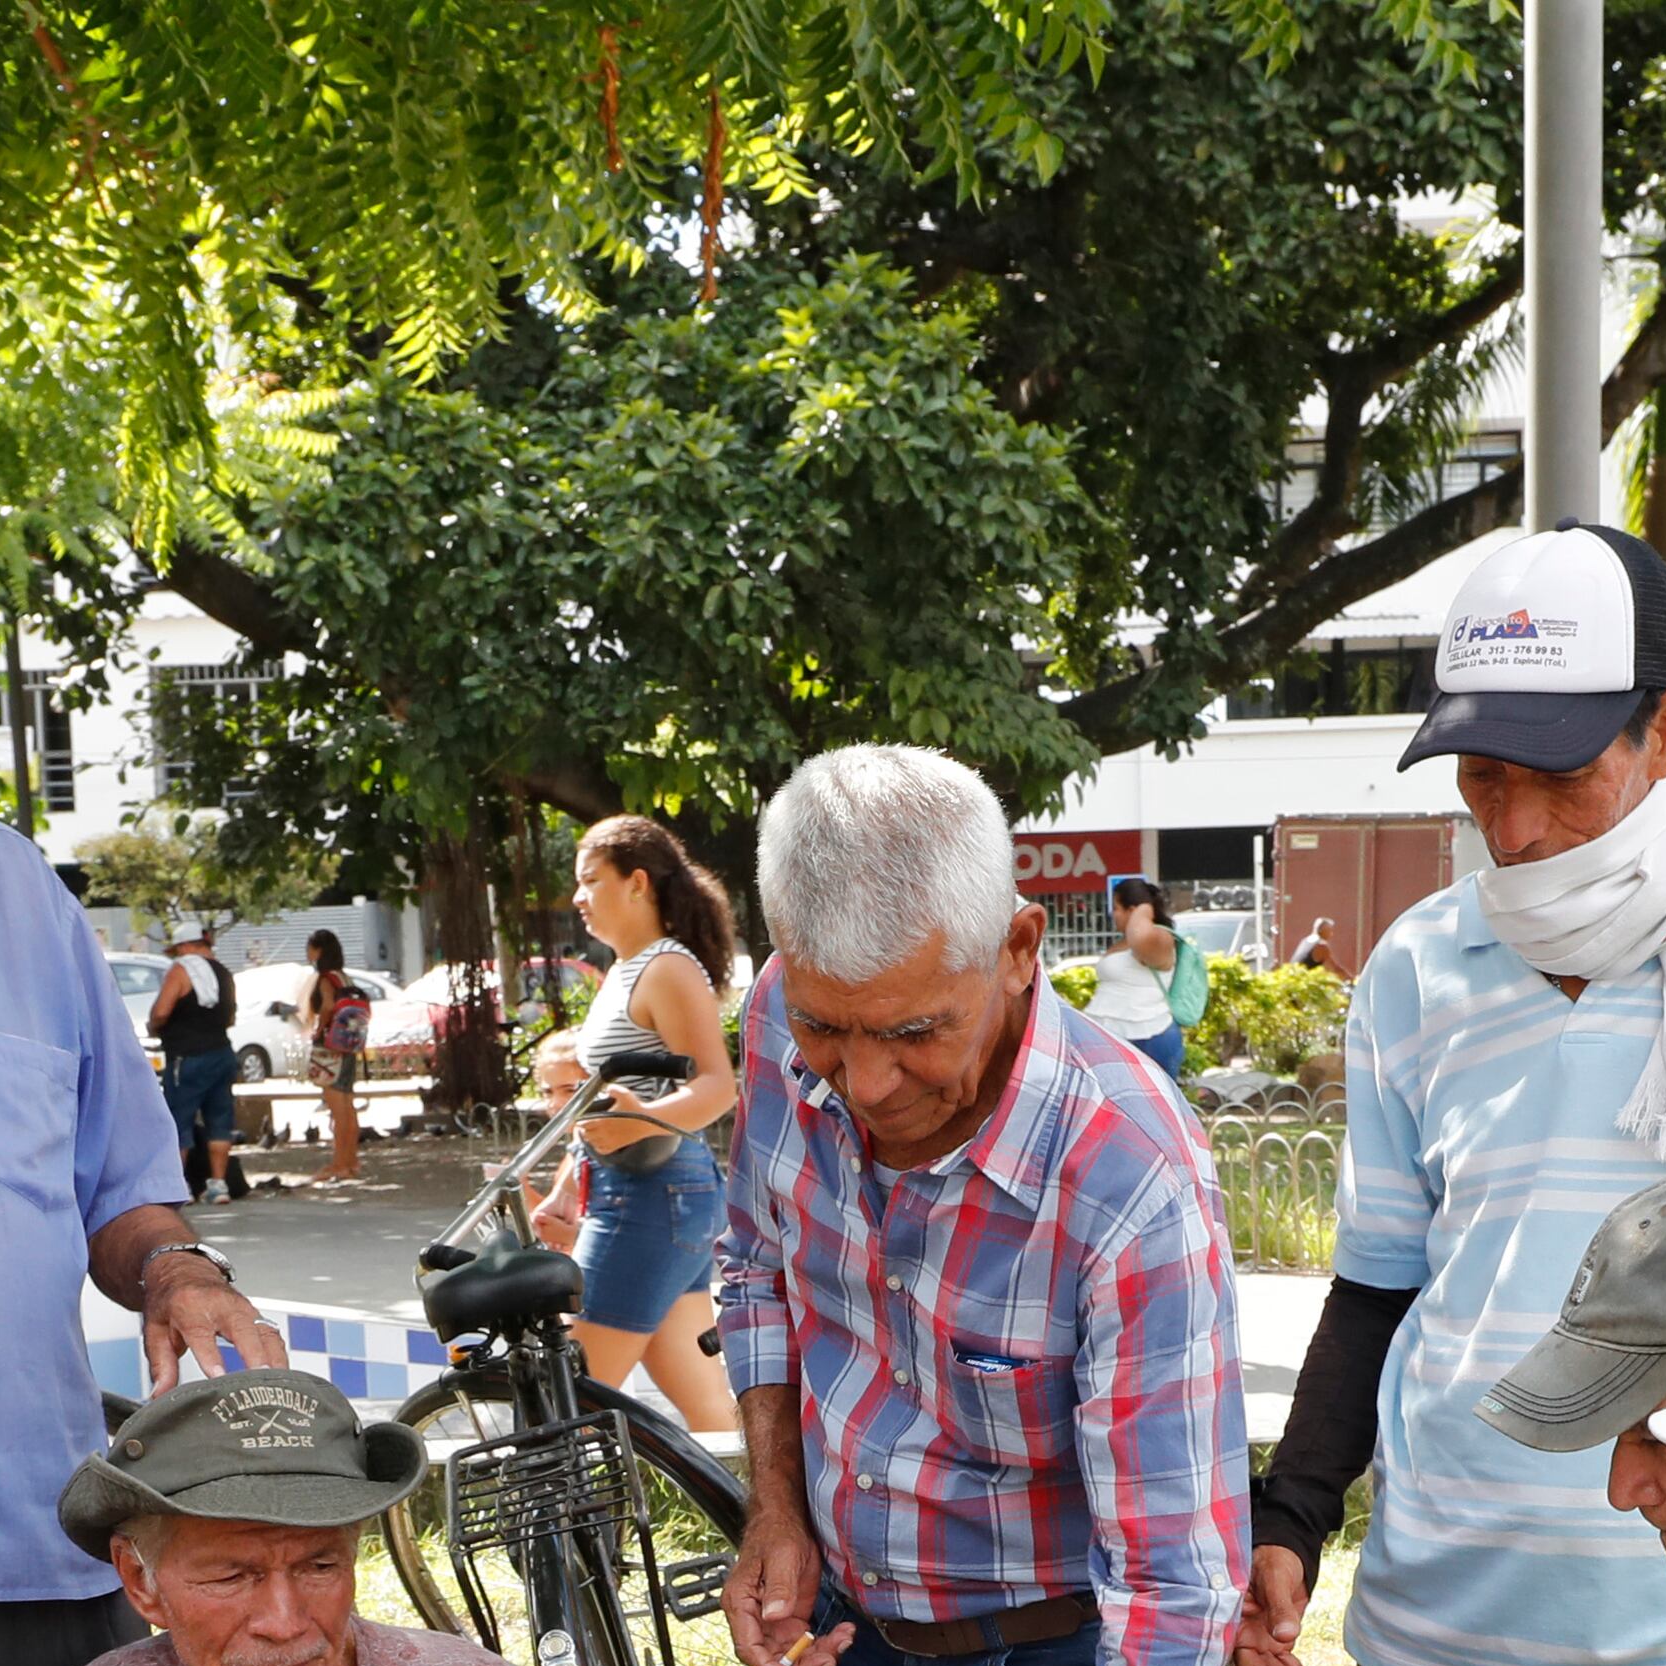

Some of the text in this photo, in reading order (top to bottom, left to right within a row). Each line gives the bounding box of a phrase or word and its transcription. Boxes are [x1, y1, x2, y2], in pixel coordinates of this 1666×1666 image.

[1468, 623, 1539, 643] PLAZA
[1449, 648, 1482, 662] CELULAR
[1488, 645, 1505, 655] 313
[1514, 645, 1532, 655] 376
[1535, 646, 1548, 655] 99
[1550, 646, 1563, 656] 83
[229, 1386, 318, 1419] LAUDERDALE
[229, 1420, 254, 1430] EST.
[241, 1435, 315, 1449] BEACH
